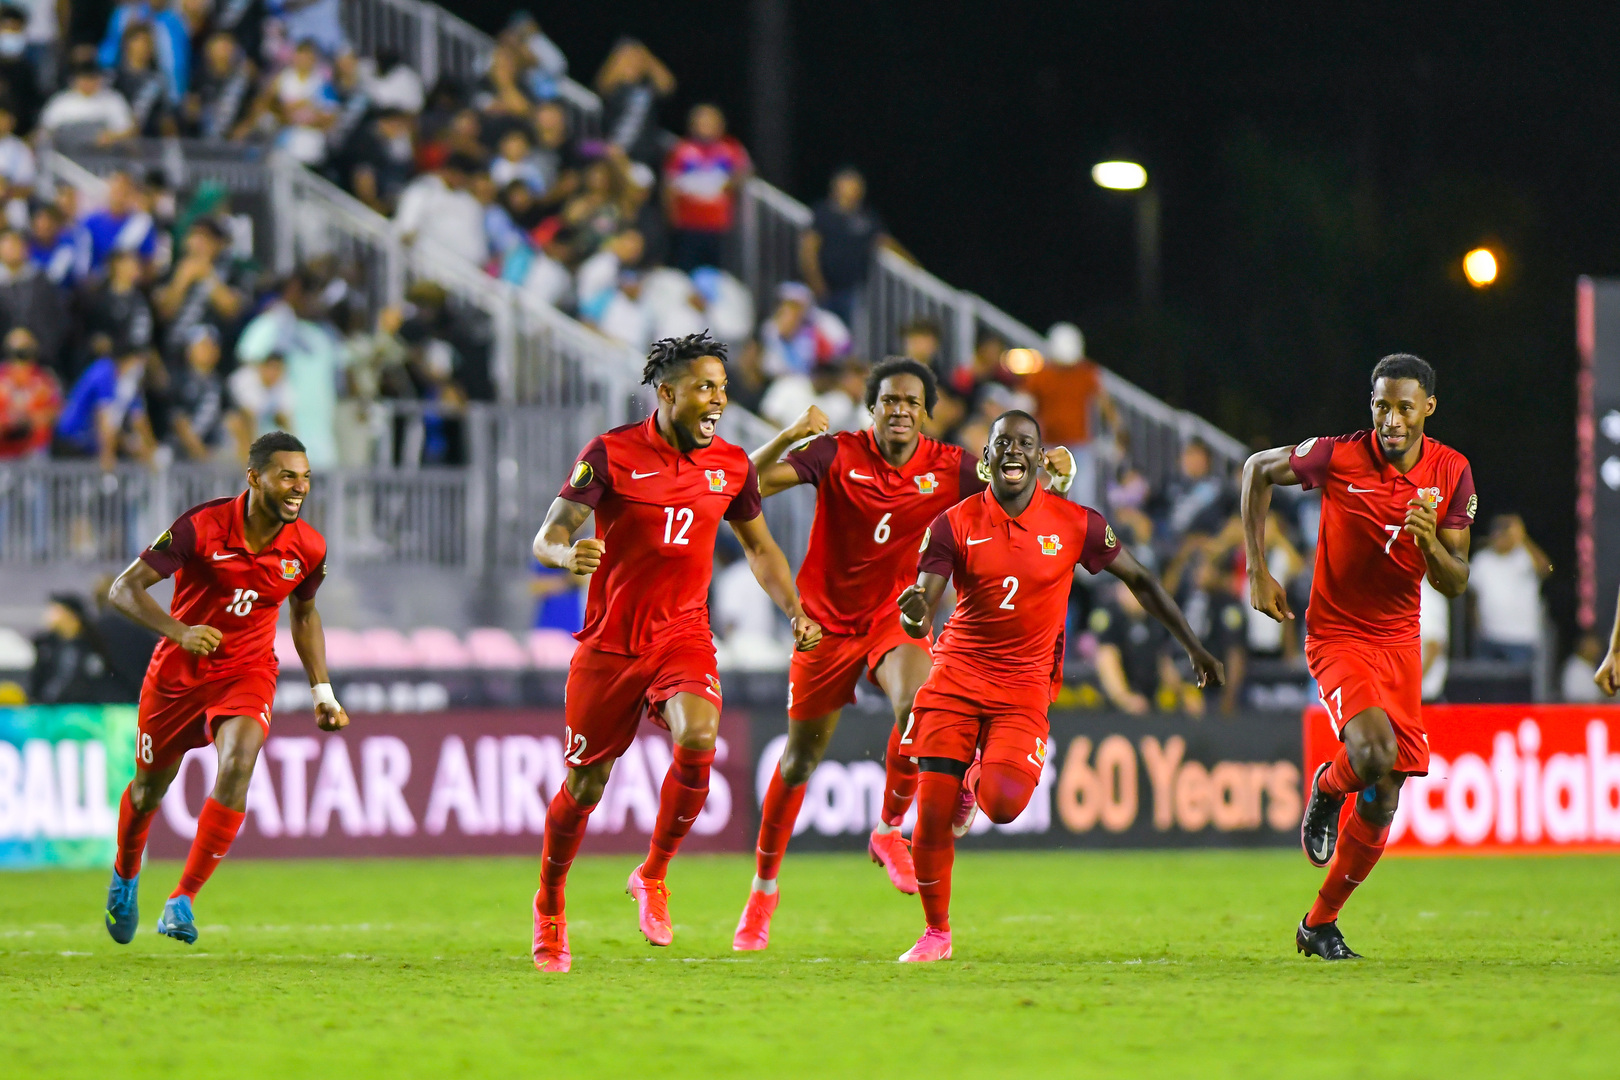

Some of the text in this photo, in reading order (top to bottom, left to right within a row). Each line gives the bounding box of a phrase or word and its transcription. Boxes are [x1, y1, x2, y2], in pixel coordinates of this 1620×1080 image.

[664, 507, 694, 545] 12
[873, 512, 892, 544] 6
[1384, 524, 1401, 554] 7
[225, 588, 259, 617] 18
[999, 576, 1019, 610] 2
[564, 725, 587, 765] 12
[900, 712, 915, 744] 2
[1056, 734, 1139, 833] 60
[1140, 734, 1302, 833] Years
[1386, 717, 1620, 846] cotiab
